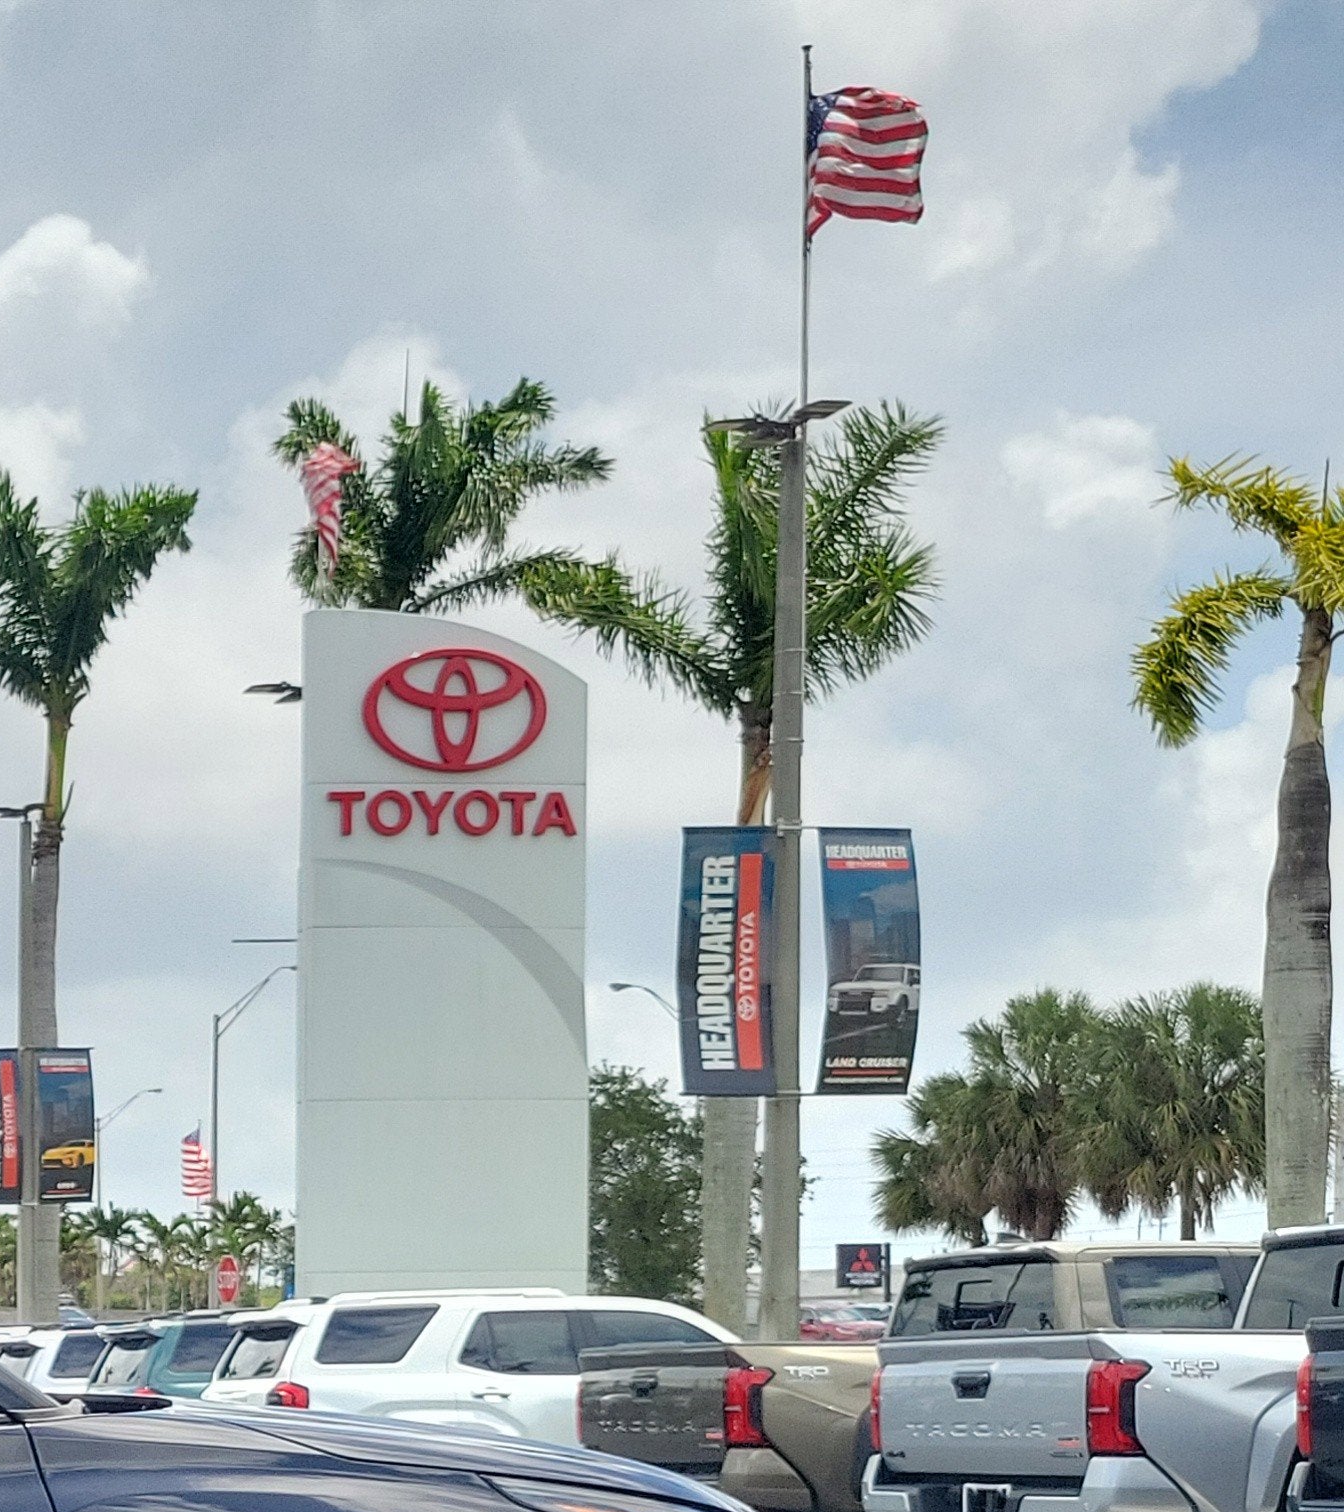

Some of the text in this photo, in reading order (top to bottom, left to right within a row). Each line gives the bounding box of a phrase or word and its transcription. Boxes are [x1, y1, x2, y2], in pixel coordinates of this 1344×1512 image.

[327, 789, 578, 837] TOYOTA
[696, 855, 736, 1070] HEADQUARTER
[738, 911, 755, 993] TOYOTA
[905, 1422, 1047, 1438] TACOMA
